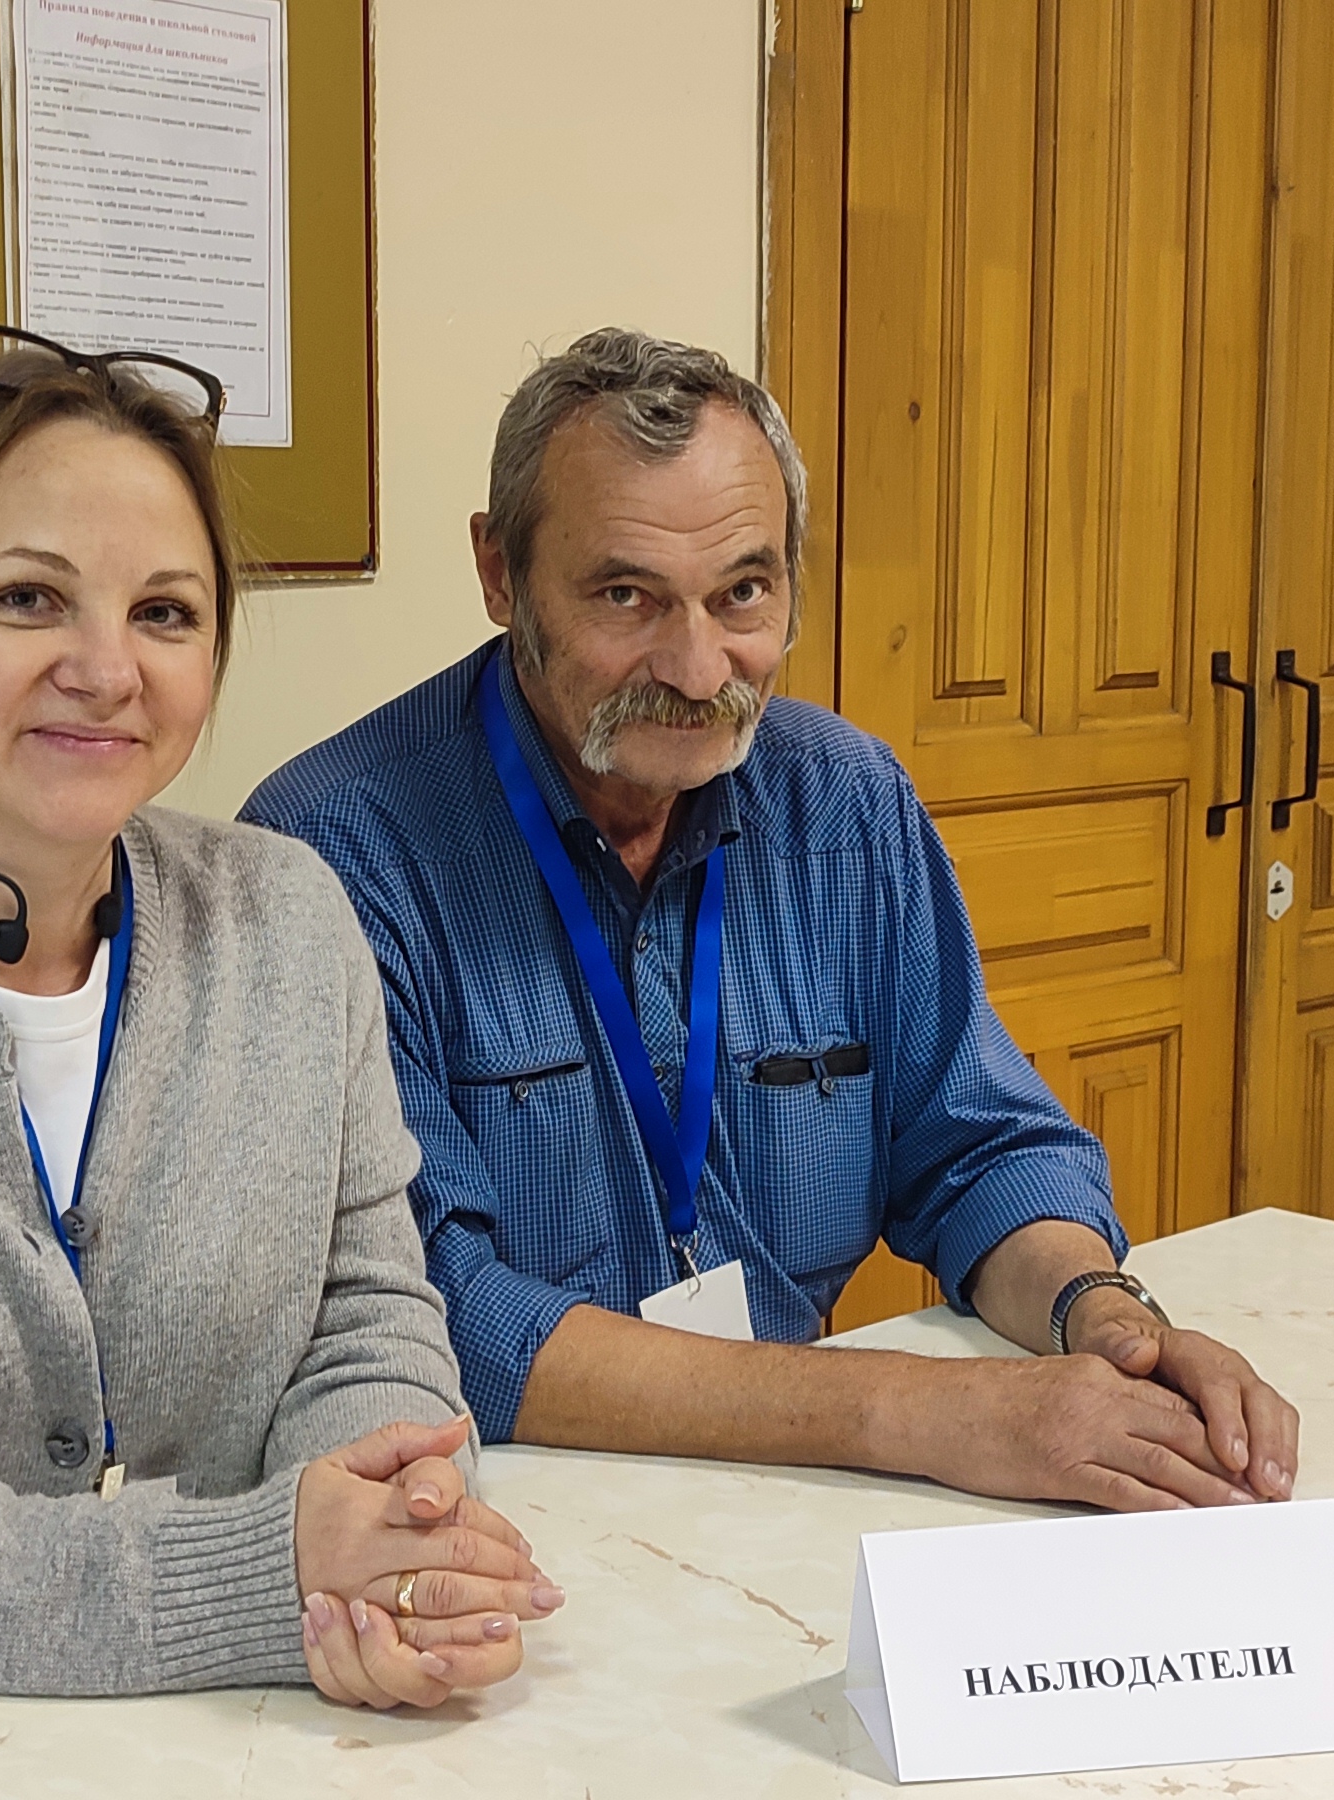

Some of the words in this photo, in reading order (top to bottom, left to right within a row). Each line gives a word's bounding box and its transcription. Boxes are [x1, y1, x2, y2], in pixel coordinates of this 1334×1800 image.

[39, 0, 89, 13] Правила
[92, 7, 147, 24] поведения
[150, 17, 156, 26] в
[158, 18, 209, 34] школьной
[212, 28, 256, 43] столовой
[76, 31, 143, 52] Информация
[145, 42, 164, 55] для
[166, 48, 229, 65] школьников
[962, 1645, 1297, 1698] НАБЛЮДАТЕЛИ
